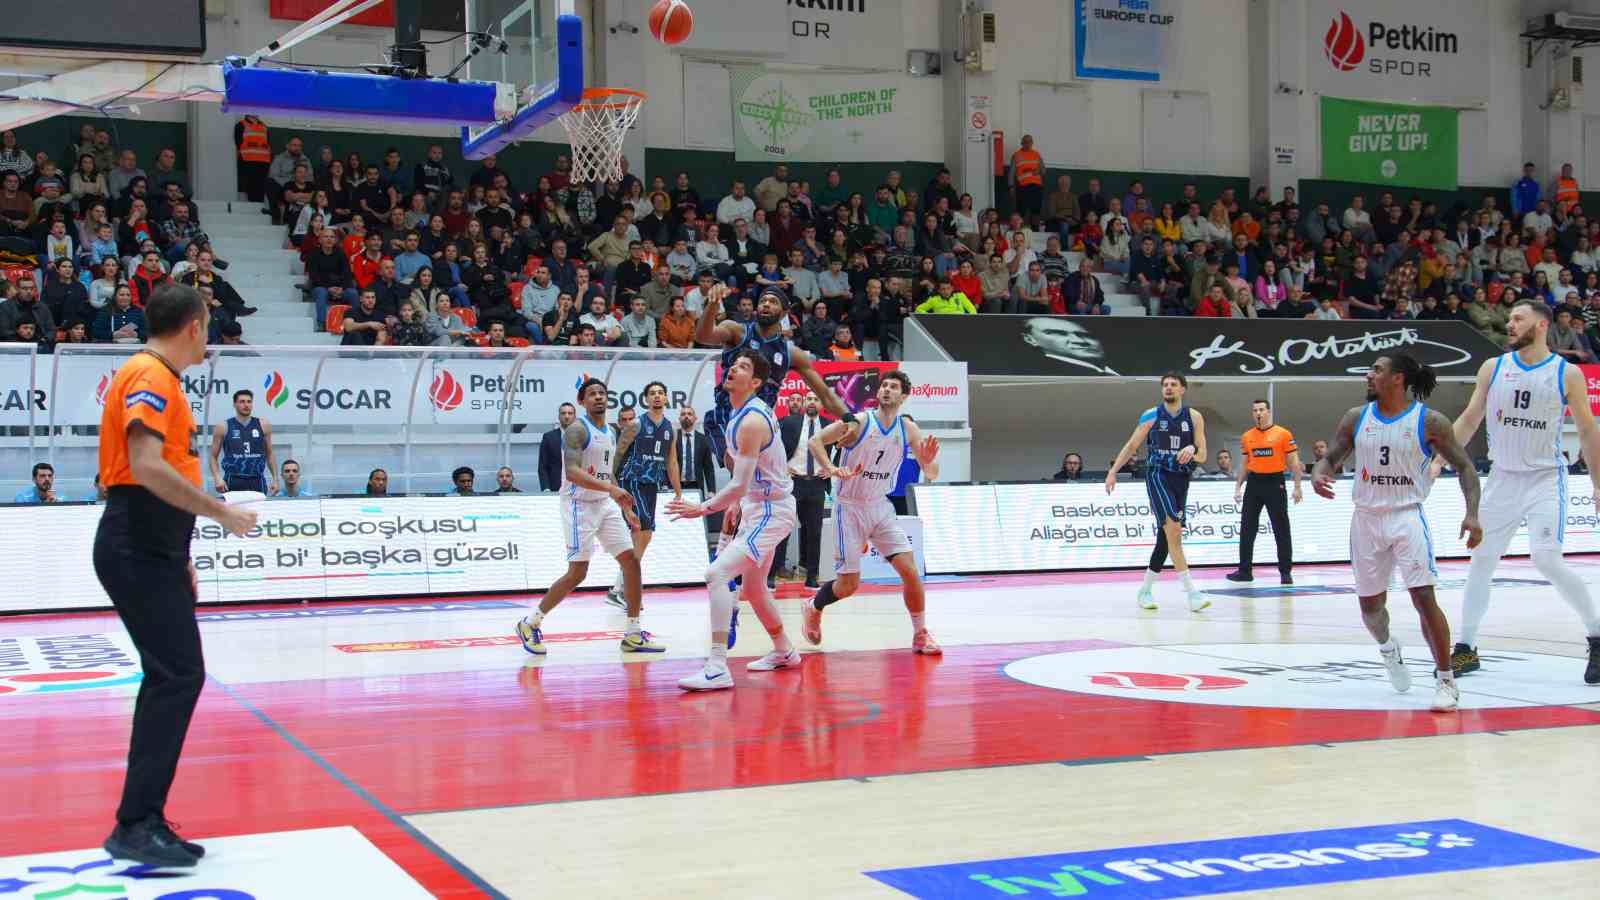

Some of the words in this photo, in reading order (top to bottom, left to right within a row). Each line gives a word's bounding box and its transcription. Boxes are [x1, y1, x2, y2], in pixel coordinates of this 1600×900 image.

[1094, 8, 1146, 23] EUROPE
[1149, 14, 1175, 24] CUP
[1369, 22, 1458, 53] Petkim
[1369, 58, 1431, 77] SPOR
[808, 92, 876, 108] CHILDREN
[880, 89, 897, 101] OF
[817, 108, 843, 120] THE
[847, 103, 893, 117] NORTH
[1358, 114, 1421, 133] NEVER
[1349, 133, 1393, 152] GIVE
[1398, 132, 1428, 150] UP!
[181, 374, 229, 394] kim
[0, 389, 46, 410] AR
[296, 389, 391, 410] SOCAR
[607, 390, 687, 410] SOCR
[1513, 389, 1531, 410] 19
[242, 441, 250, 453] 3
[1169, 435, 1181, 449] 10
[875, 450, 885, 465] 7
[1379, 445, 1391, 466] 3
[338, 516, 477, 539] coşkusu
[1030, 523, 1119, 543] Aliağa'da
[277, 548, 308, 568] bi'
[321, 546, 421, 569] başka
[433, 541, 519, 567] güzel!
